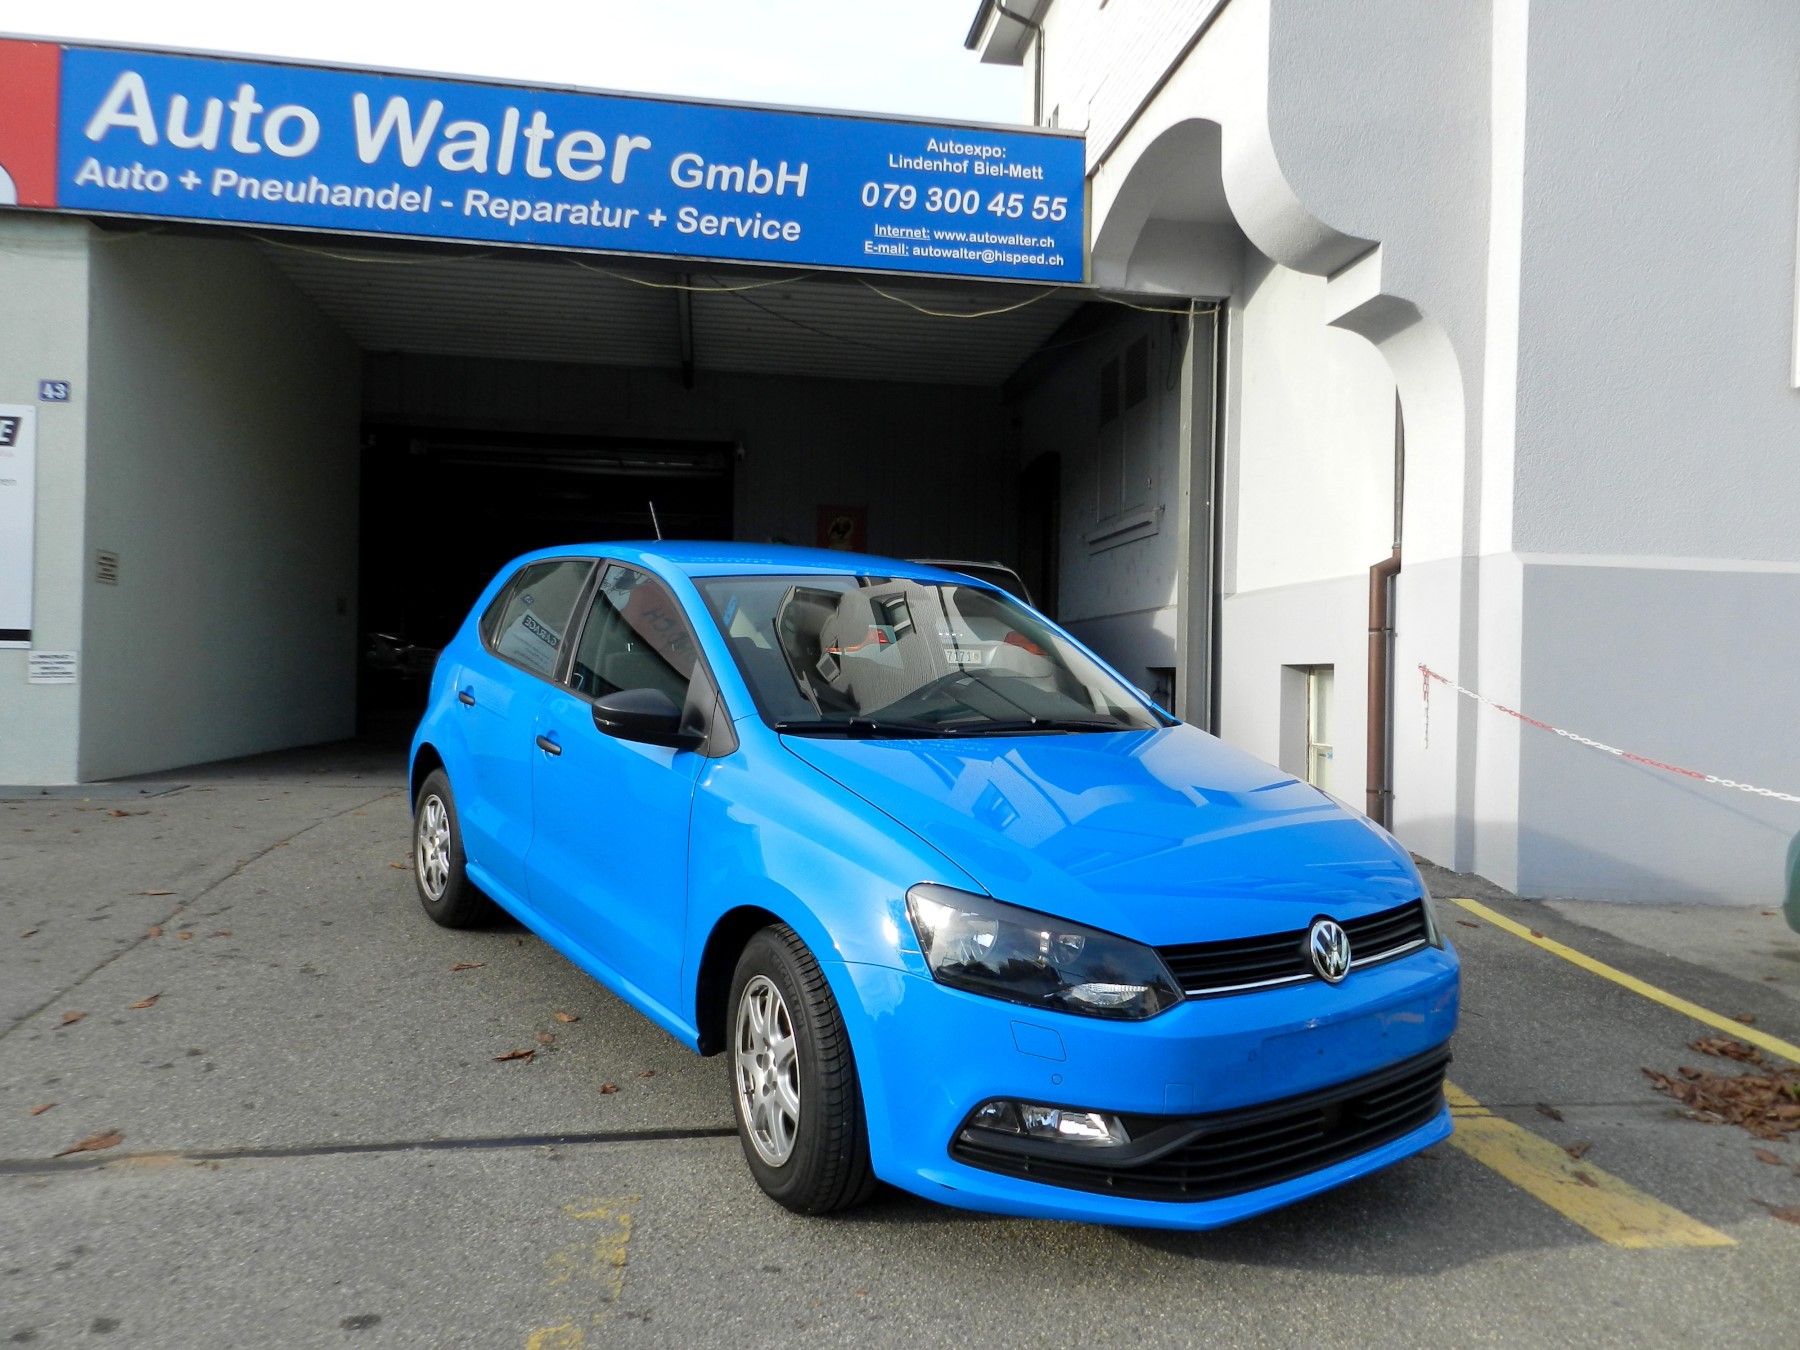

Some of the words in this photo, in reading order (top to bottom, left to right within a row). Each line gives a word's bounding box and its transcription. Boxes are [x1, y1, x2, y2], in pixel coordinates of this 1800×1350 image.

[85, 71, 320, 157] Auto
[353, 92, 651, 185] Walter
[671, 153, 808, 197] GmbH
[927, 138, 1007, 159] Autoexpo:
[889, 153, 969, 173] Lindenhof
[975, 161, 1044, 180] Biel-Mett
[75, 158, 168, 192] Auto
[212, 167, 433, 213] Pneuhandel
[464, 189, 640, 229] Reparatur
[677, 206, 801, 242] Service
[862, 182, 917, 209] 079
[925, 187, 980, 214] 300
[987, 193, 1025, 218] 45
[1032, 196, 1068, 221] 55
[874, 223, 931, 240] Internet:
[934, 231, 1055, 248] www.autowalter.ch
[864, 241, 909, 256] E-mail:
[913, 246, 1064, 266] autowalter@hispeed.ch
[43, 383, 66, 399] 43
